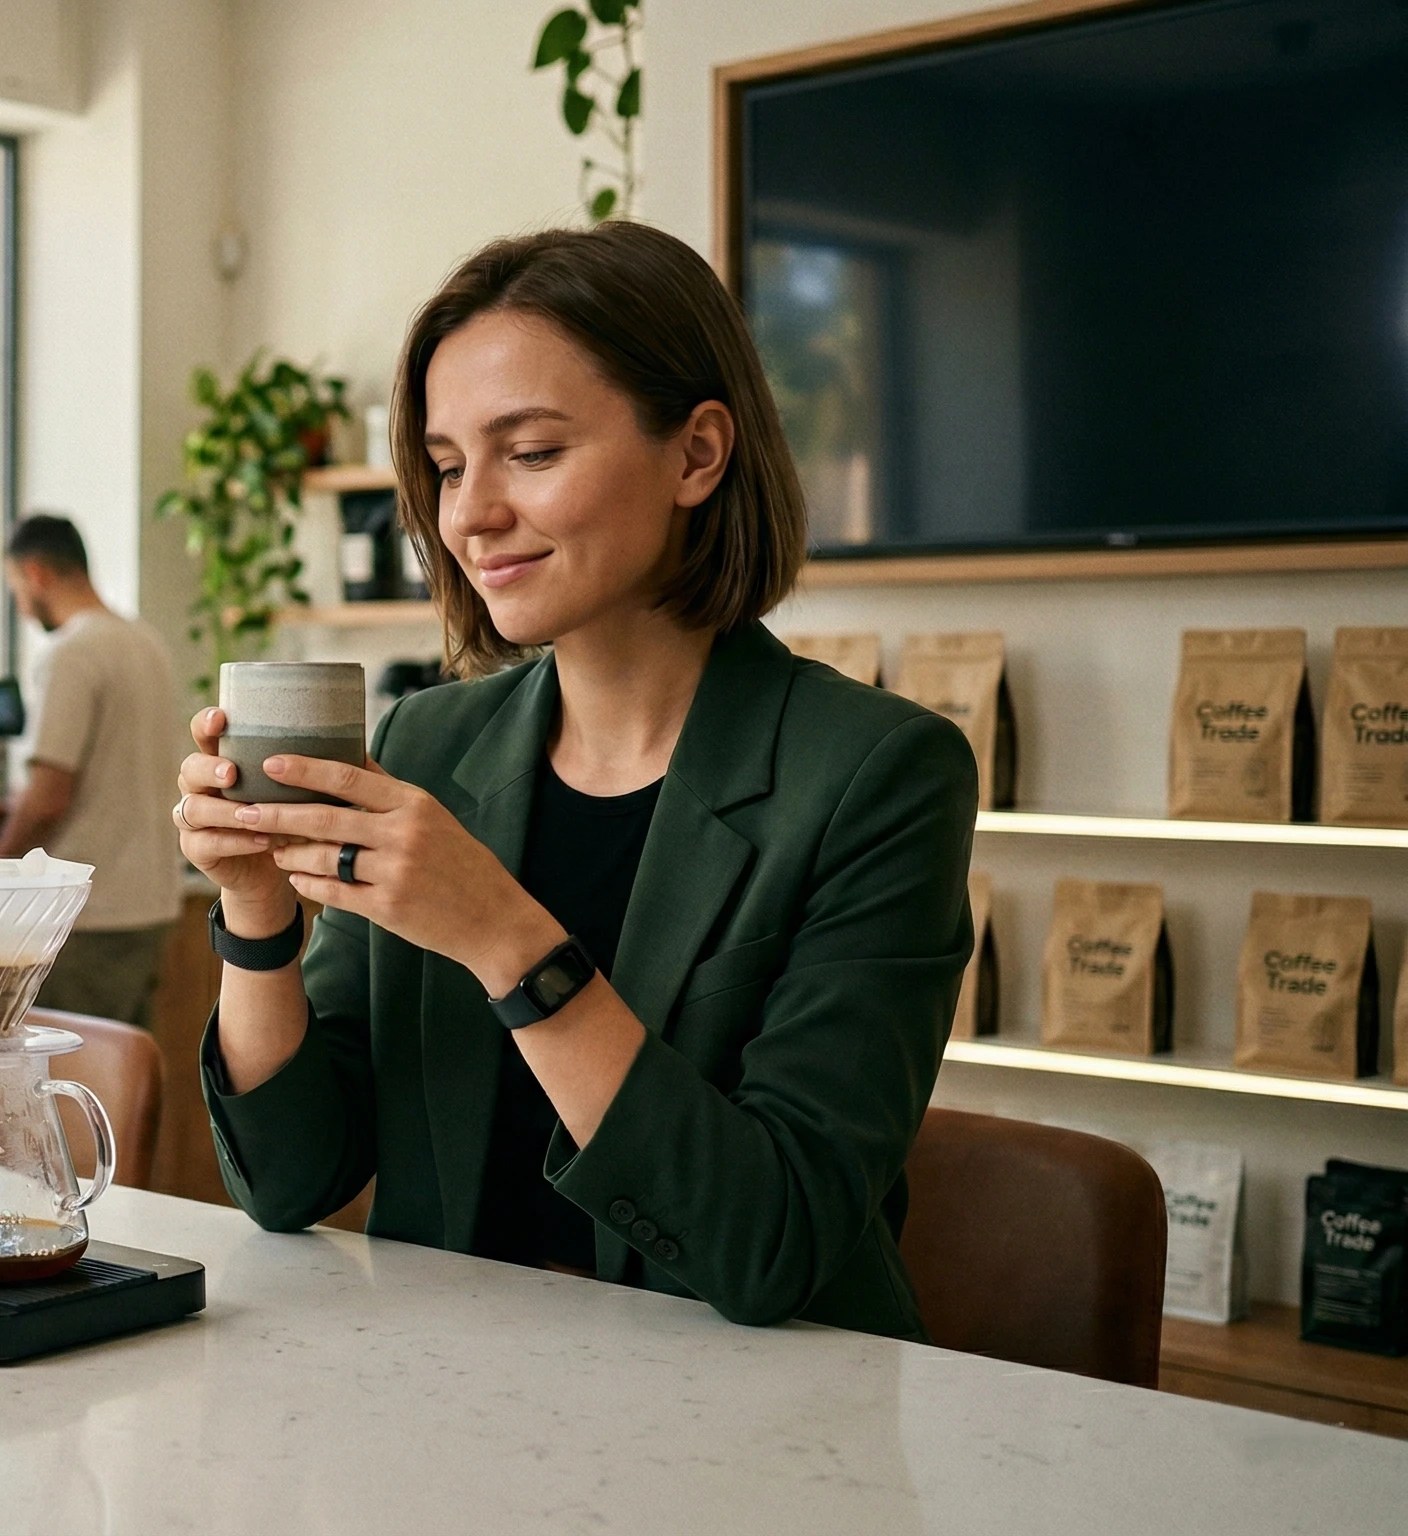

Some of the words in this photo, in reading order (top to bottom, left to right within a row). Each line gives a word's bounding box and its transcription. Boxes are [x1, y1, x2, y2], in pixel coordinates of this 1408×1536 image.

[1196, 701, 1268, 720] Coffee
[1350, 702, 1408, 722] Coffe
[1201, 723, 1260, 743] Trade
[1354, 722, 1408, 745] Trad
[1067, 935, 1133, 955] Coffee
[1263, 950, 1337, 974] Coffee
[1267, 971, 1327, 996] Trade
[1320, 1209, 1382, 1235] Coffee
[1325, 1229, 1376, 1252] Trade
